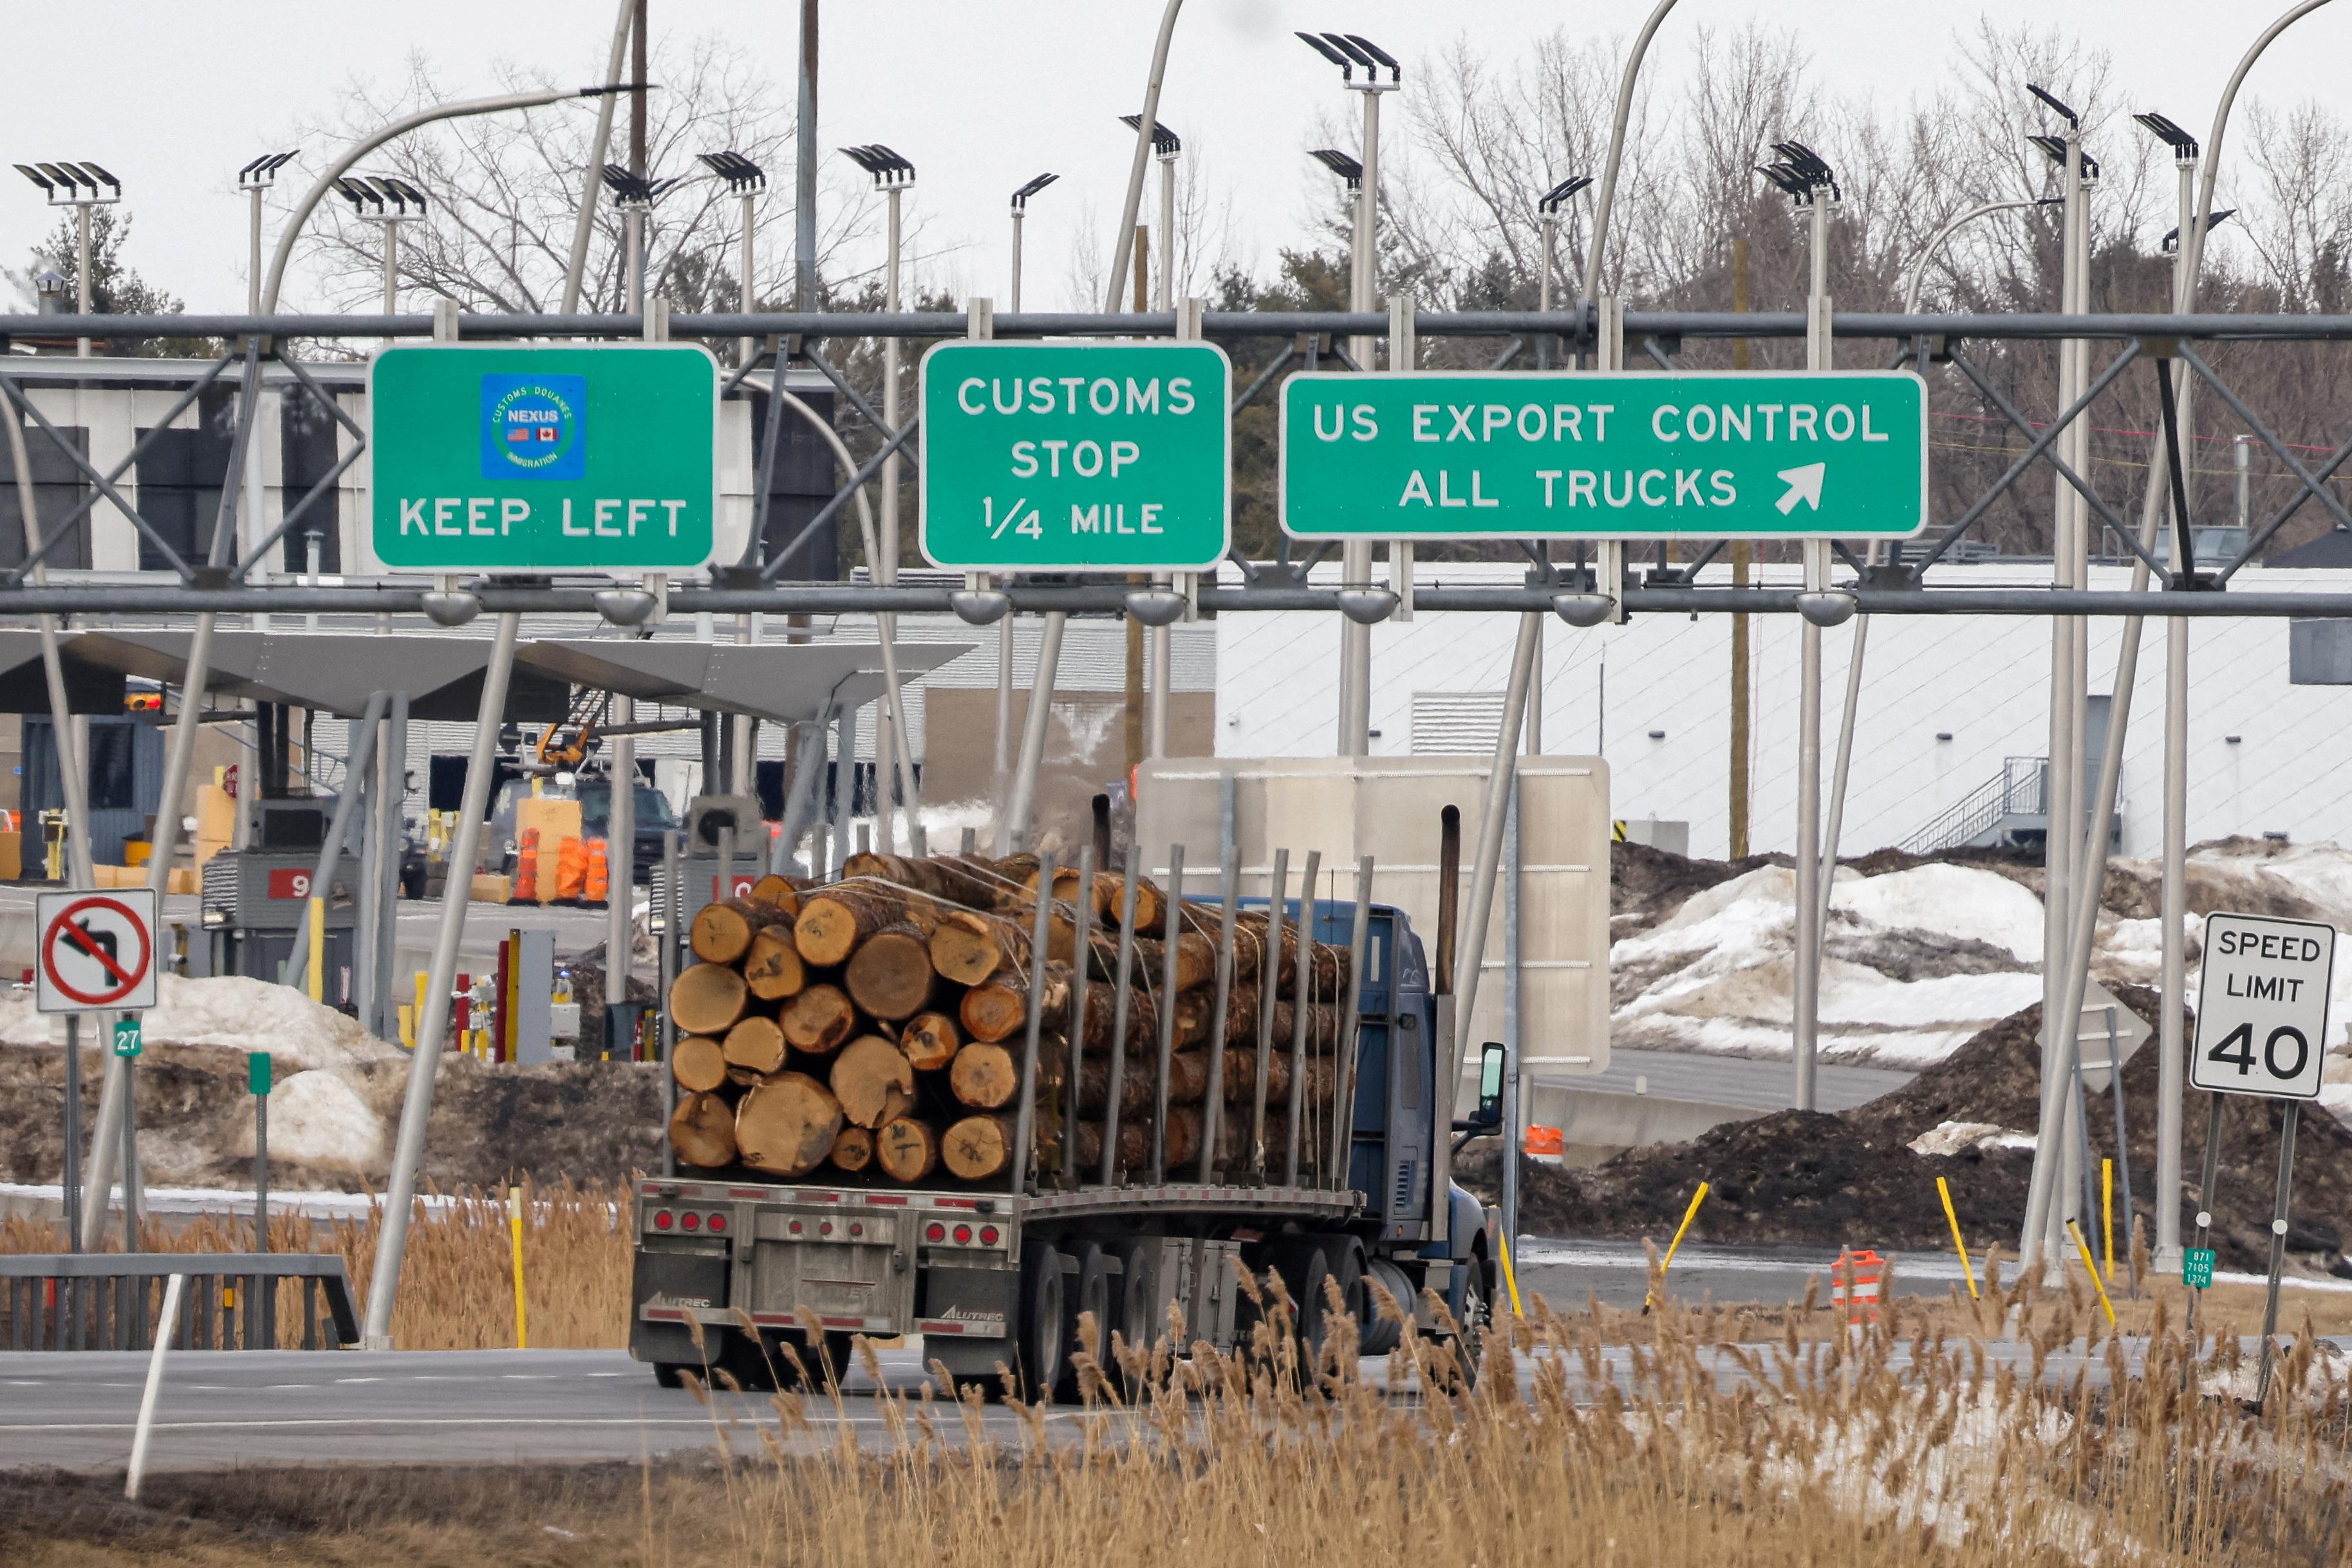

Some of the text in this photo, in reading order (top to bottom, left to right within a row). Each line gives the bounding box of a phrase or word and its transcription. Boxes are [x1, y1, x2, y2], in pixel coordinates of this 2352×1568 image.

[492, 386, 572, 423] CUSTOMS DOUANES
[958, 377, 1195, 415] CUSTOMS
[507, 409, 559, 424] NEXUS
[1314, 404, 1889, 442] US EXPORT CONTROL
[1011, 440, 1140, 478] STOP
[1398, 469, 1737, 508] ALL TRUCKS
[400, 498, 687, 537] KEEP LEFT
[983, 496, 1164, 539] 1/4 MILE
[292, 875, 309, 897] 9
[2218, 930, 2320, 962] SPEED
[2227, 973, 2304, 1002] LIMIT
[117, 1030, 139, 1051] 27
[2208, 1022, 2308, 1079] 40
[2188, 1262, 2209, 1273] 7105
[2194, 1251, 2208, 1262] 871
[2188, 1274, 2207, 1284] 1374
[940, 1303, 1004, 1321] ALUTREC
